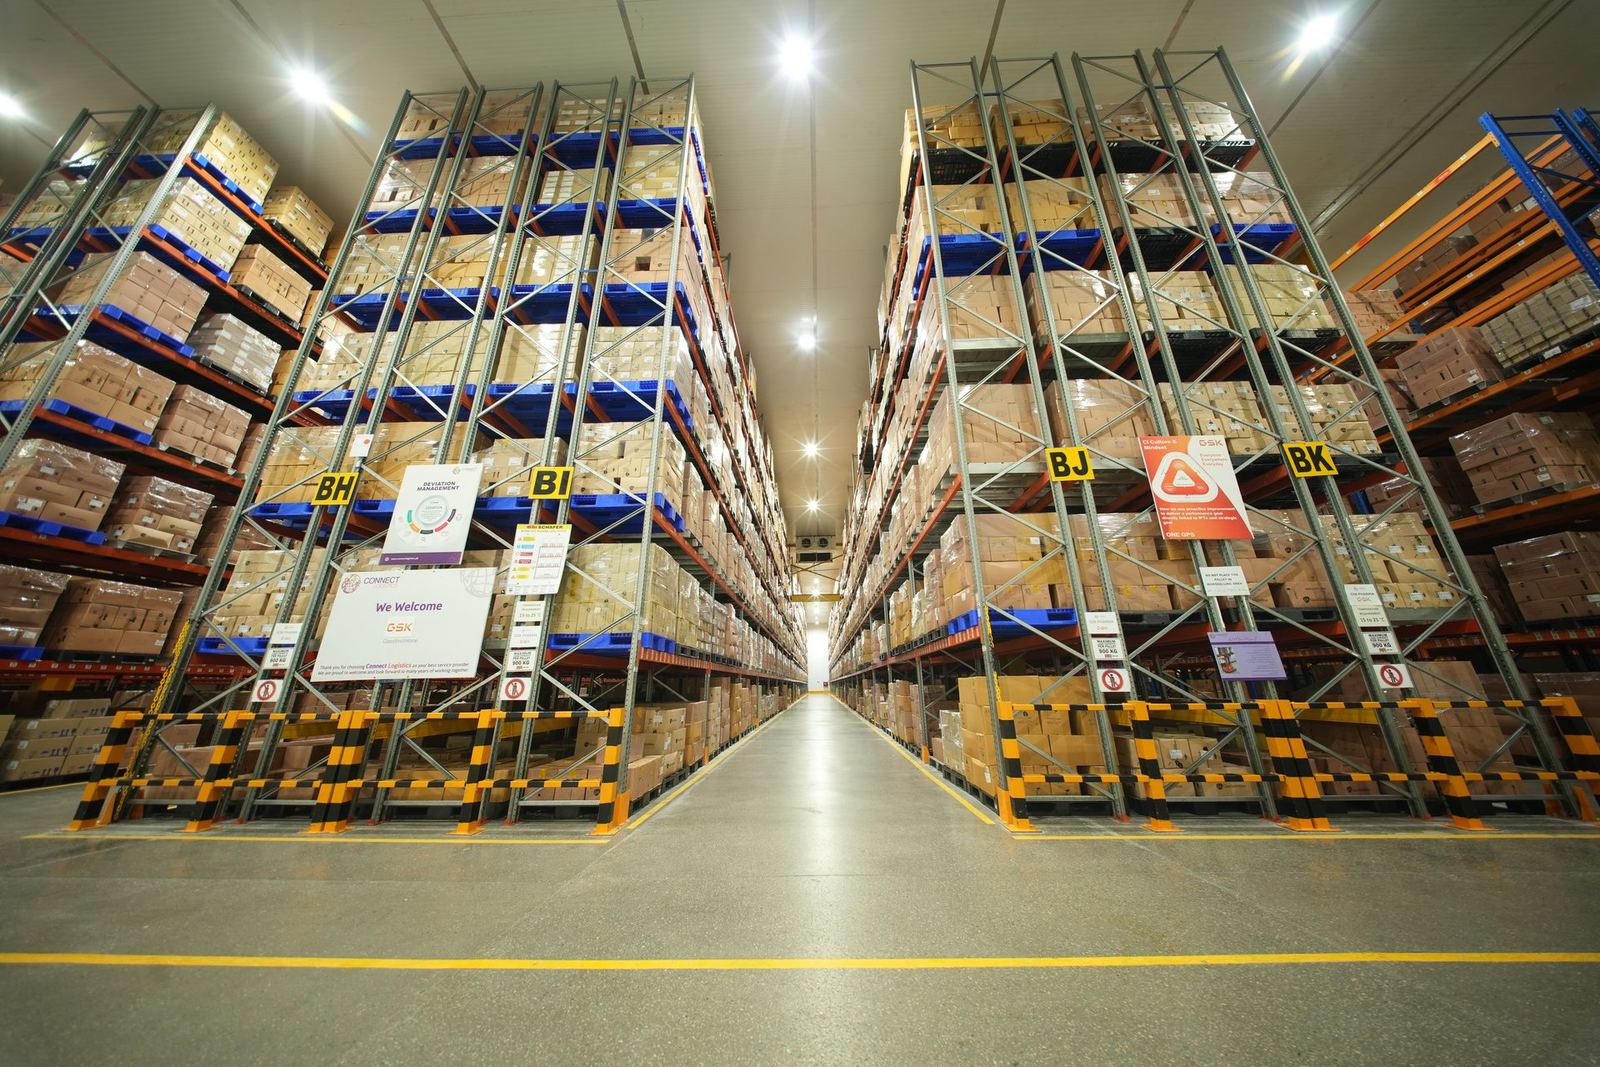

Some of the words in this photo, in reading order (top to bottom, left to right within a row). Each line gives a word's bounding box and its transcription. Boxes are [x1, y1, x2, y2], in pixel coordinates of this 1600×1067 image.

[1050, 451, 1088, 477] BJ
[1288, 446, 1334, 472] BK
[315, 476, 355, 500] BH
[533, 471, 570, 495] BI
[376, 603, 391, 612] We
[395, 602, 443, 612] Welcome
[386, 623, 413, 632] GSK
